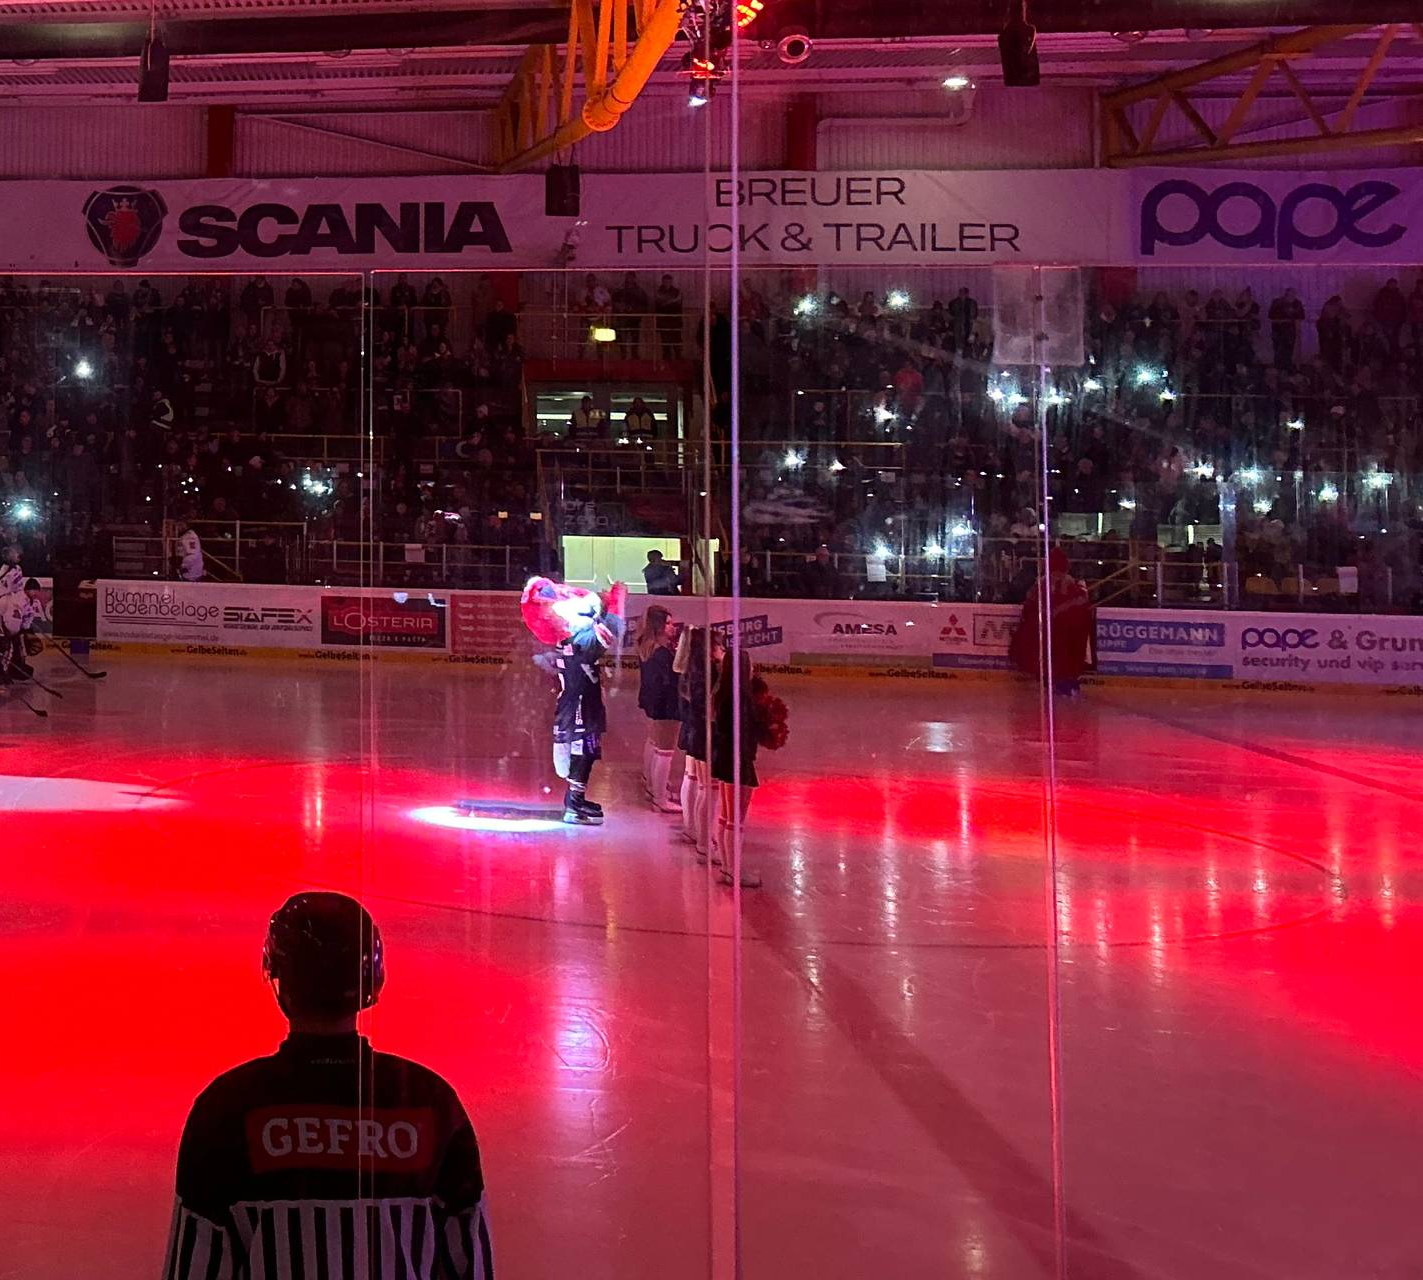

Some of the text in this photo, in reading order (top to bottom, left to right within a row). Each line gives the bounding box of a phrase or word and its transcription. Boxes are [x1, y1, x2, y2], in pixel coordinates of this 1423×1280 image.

[715, 177, 906, 207] BREUER
[177, 201, 512, 258] SCANIA
[1140, 179, 1408, 261] pape
[606, 222, 1021, 254] TRUCK & TRAILER
[833, 623, 897, 635] AMESA
[1242, 628, 1320, 651] pape
[1328, 629, 1348, 650] &
[1242, 654, 1311, 672] security
[1317, 656, 1351, 669] und
[1357, 657, 1385, 673] vip
[262, 1117, 418, 1160] GEFRO
